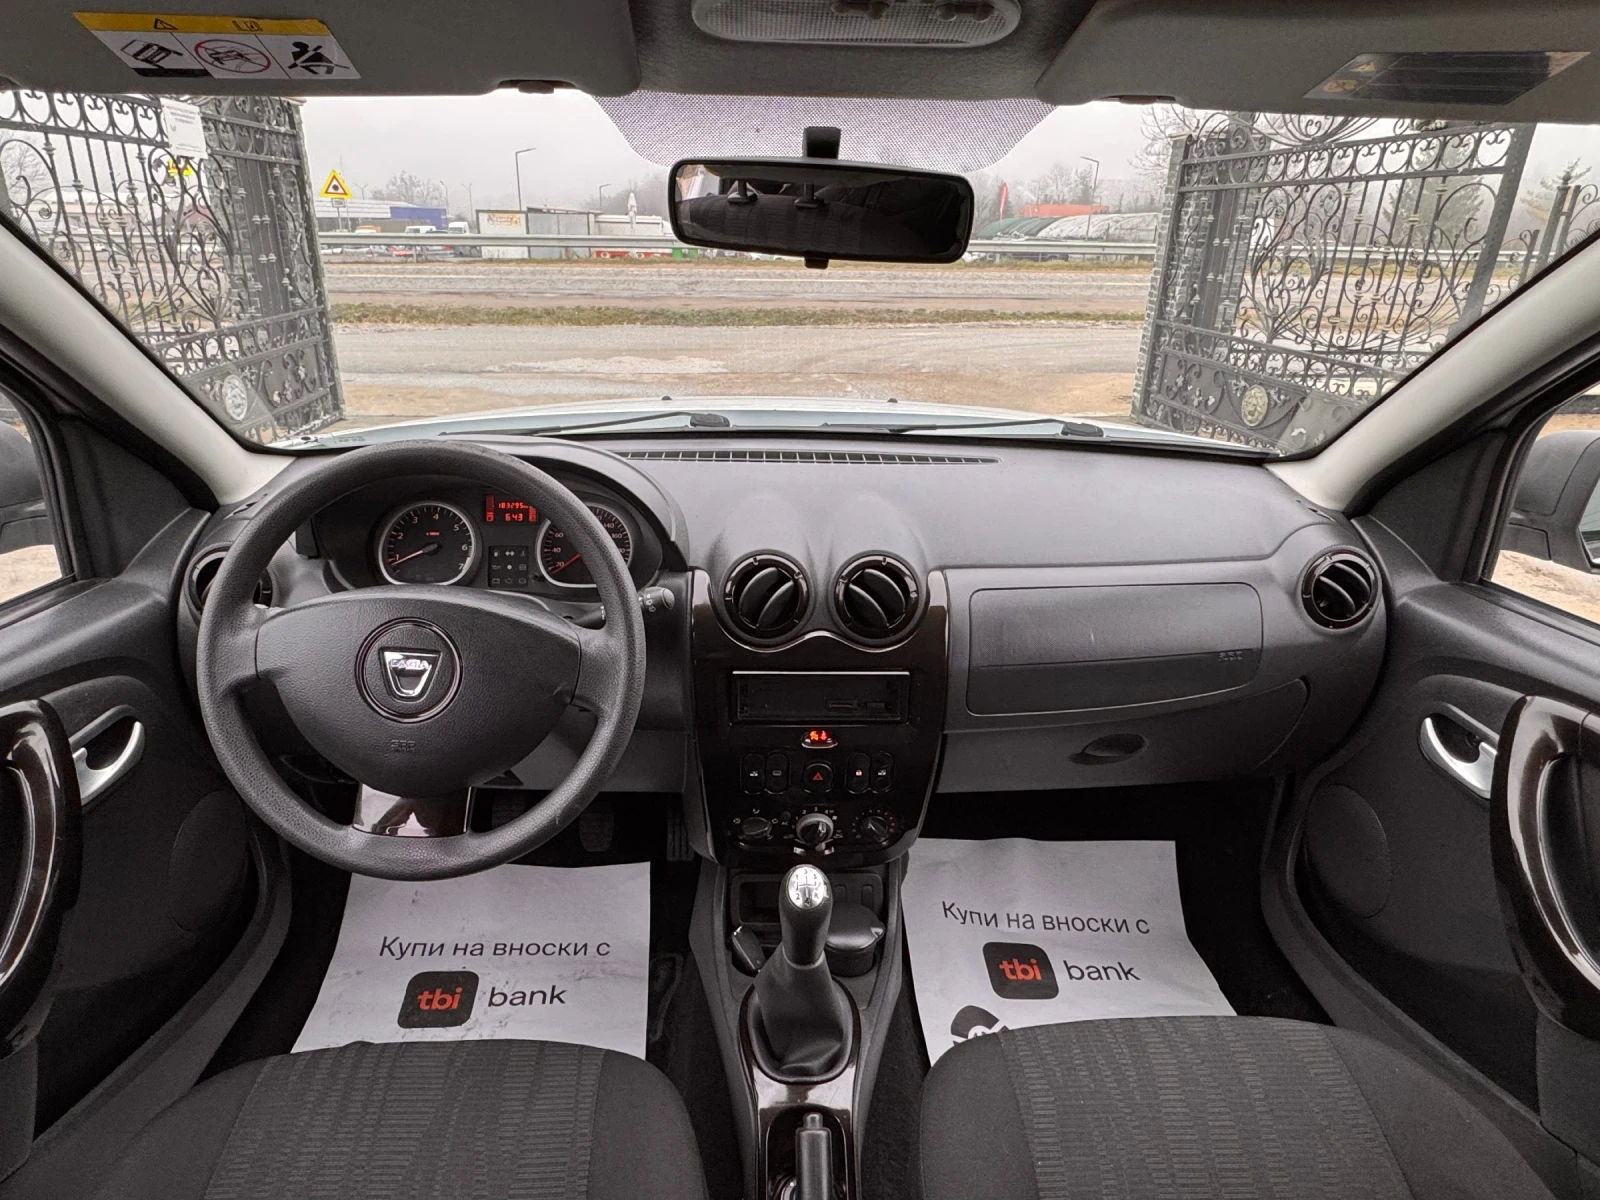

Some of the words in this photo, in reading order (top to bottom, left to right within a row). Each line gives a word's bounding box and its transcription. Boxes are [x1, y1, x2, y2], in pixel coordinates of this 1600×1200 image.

[412, 516, 418, 524] 3
[505, 513, 523, 521] 643
[942, 901, 999, 928] Купи
[1006, 912, 1036, 930] на
[1042, 914, 1130, 934] вноски
[1135, 918, 1151, 934] с
[379, 936, 445, 961] Купи
[452, 942, 485, 957] на
[492, 942, 589, 957] вноски
[595, 942, 611, 957] с
[1000, 958, 1042, 982] tbi
[1063, 959, 1141, 981] bank
[417, 986, 463, 1011] tbi
[487, 984, 568, 1007] bank
